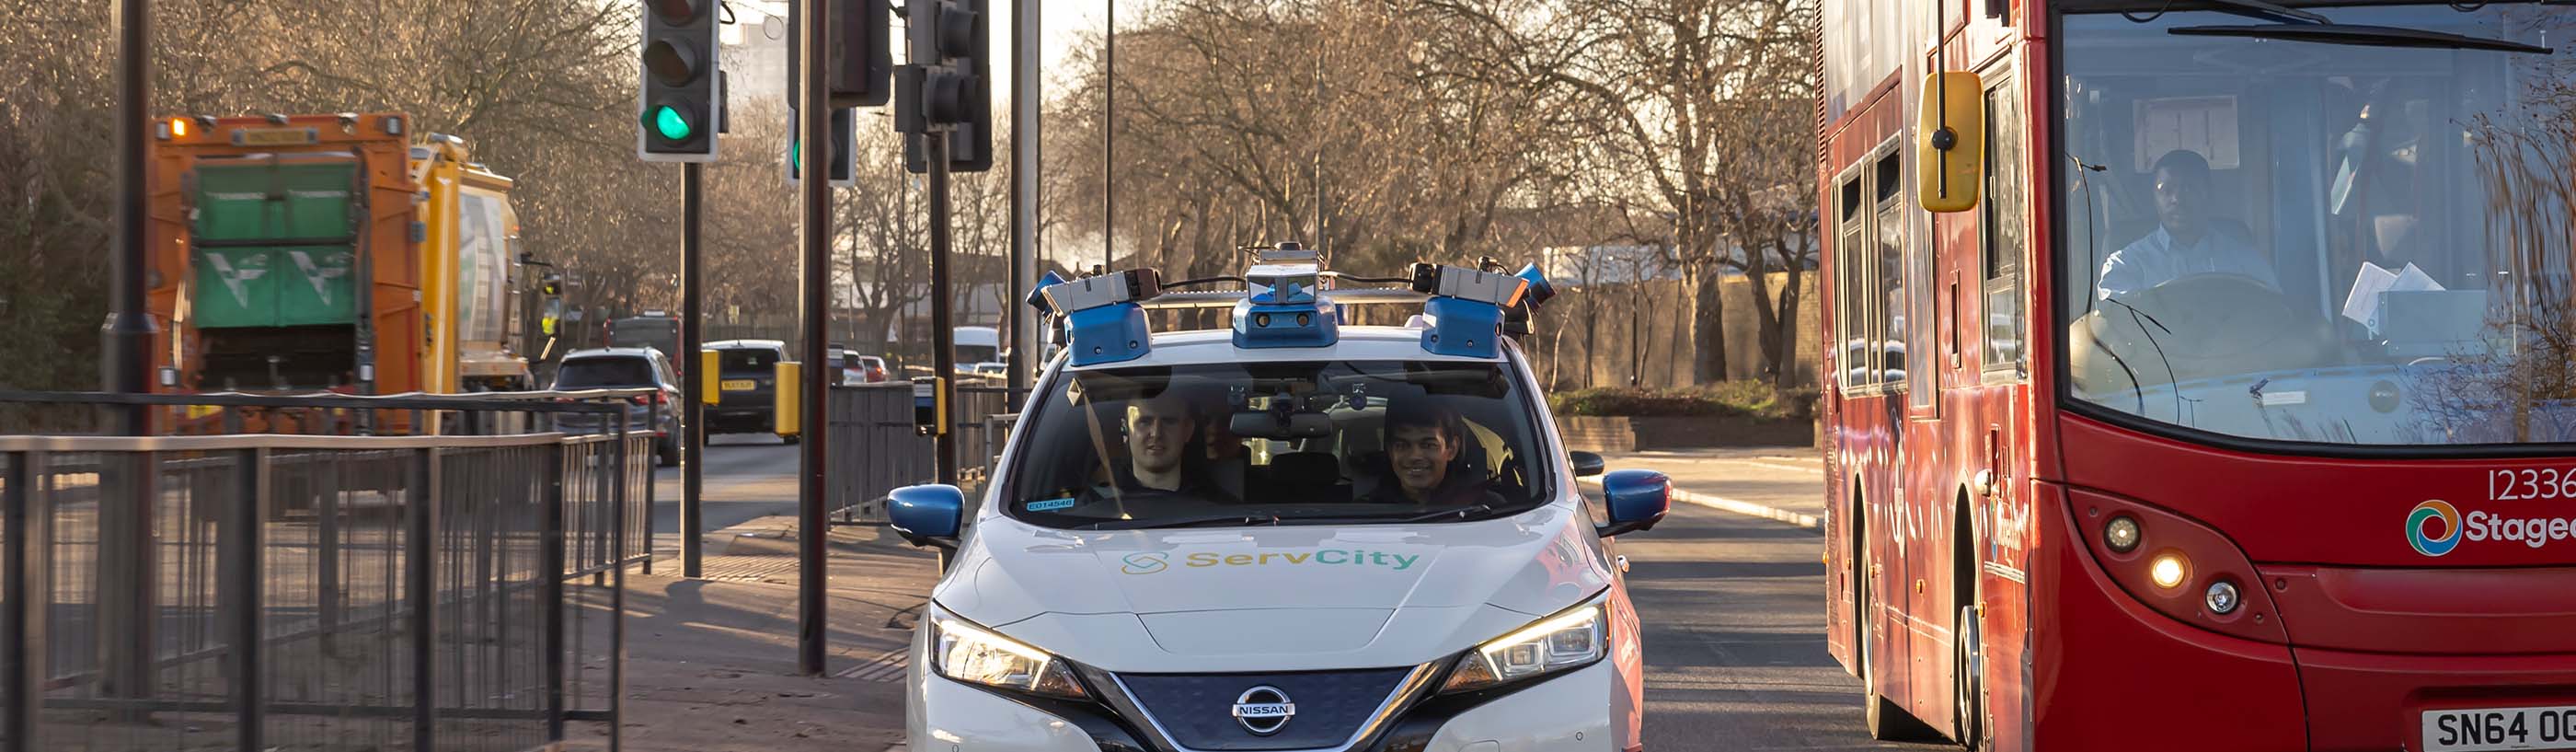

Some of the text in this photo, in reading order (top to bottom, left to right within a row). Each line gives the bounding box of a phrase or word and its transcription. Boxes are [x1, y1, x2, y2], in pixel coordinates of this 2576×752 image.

[2489, 469, 2576, 501] 12336
[1186, 550, 1420, 570] ServCity
[1239, 706, 1288, 714] NISSAN
[2438, 712, 2528, 746] SN64
